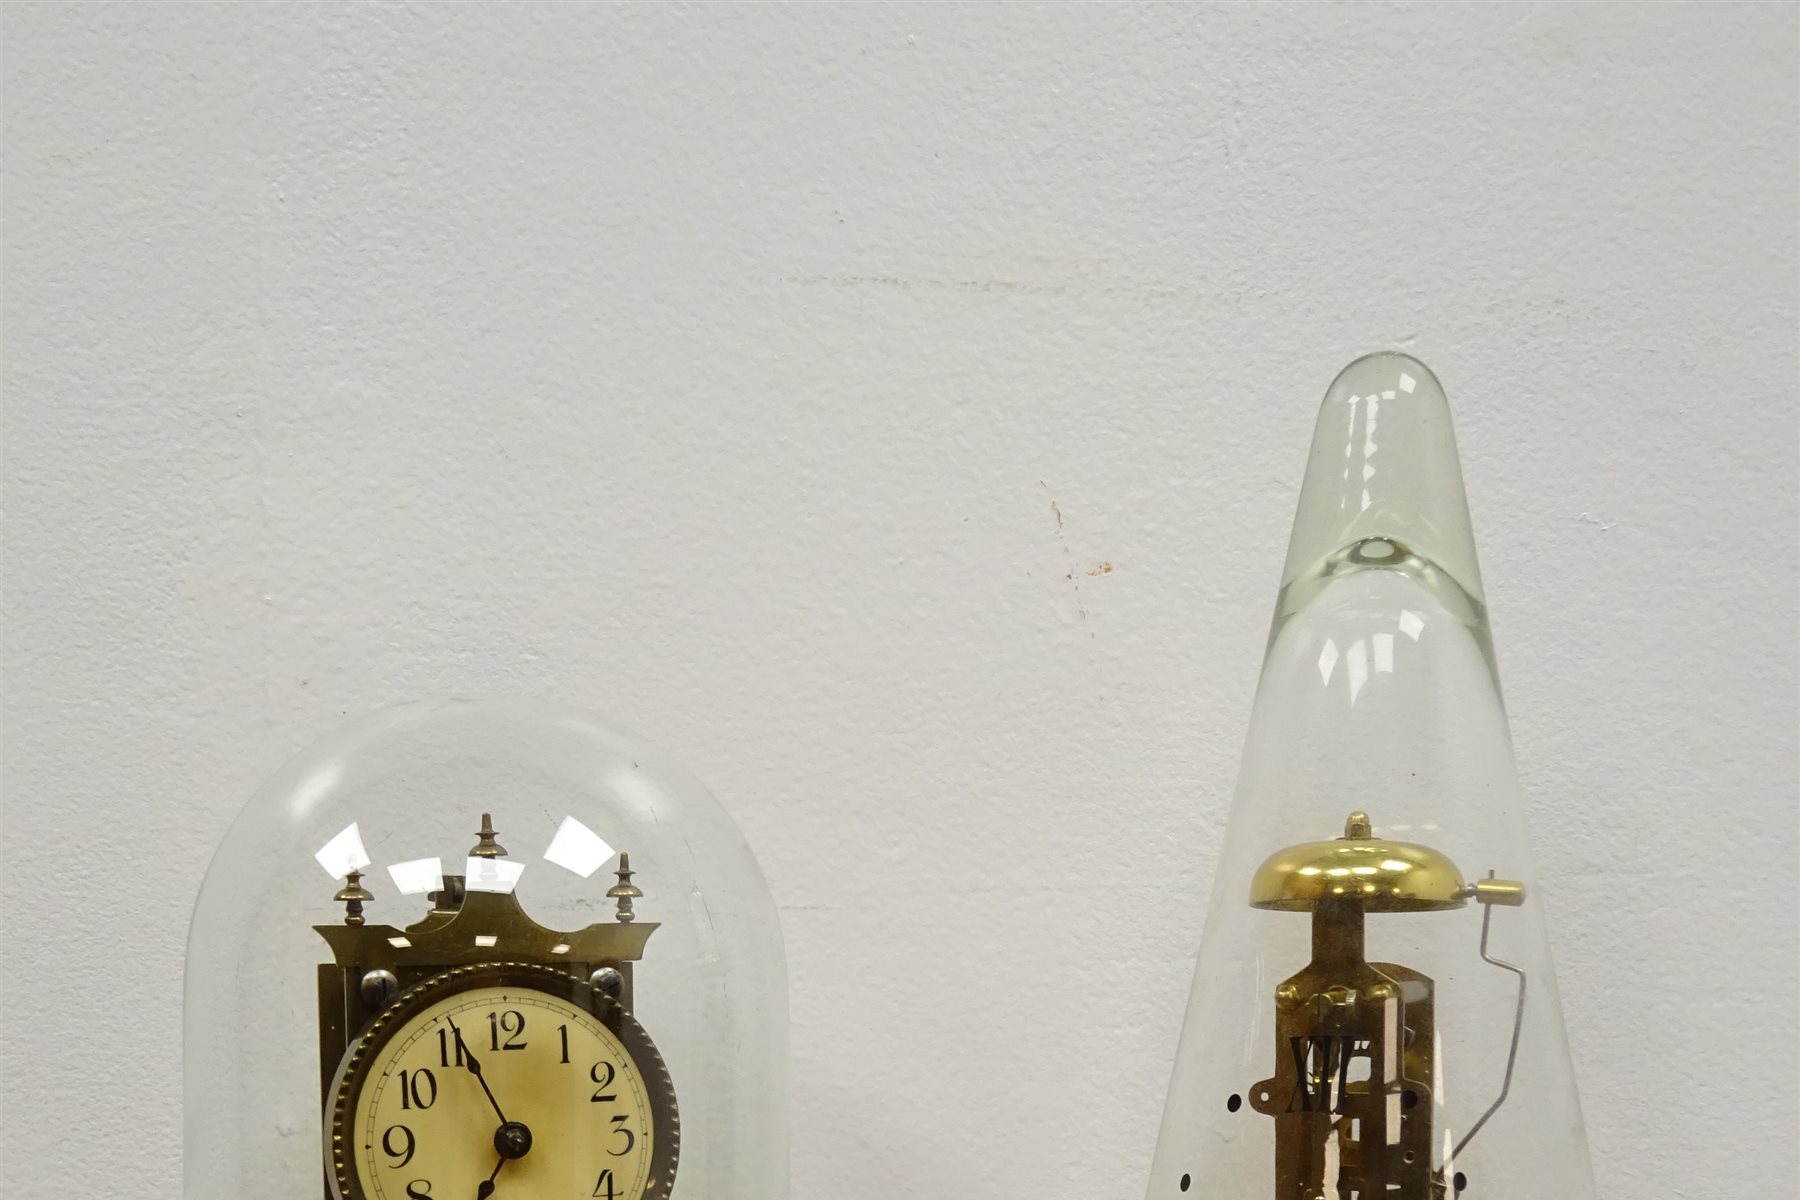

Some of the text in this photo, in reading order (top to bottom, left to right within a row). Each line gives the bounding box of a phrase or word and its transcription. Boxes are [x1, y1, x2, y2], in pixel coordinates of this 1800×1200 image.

[436, 1027, 466, 1068] 11
[487, 1010, 528, 1051] 12
[556, 1024, 571, 1064] 1
[398, 1068, 437, 1110] 10
[590, 1061, 618, 1103] 2
[382, 1125, 416, 1169] 9
[606, 1114, 635, 1156] 3
